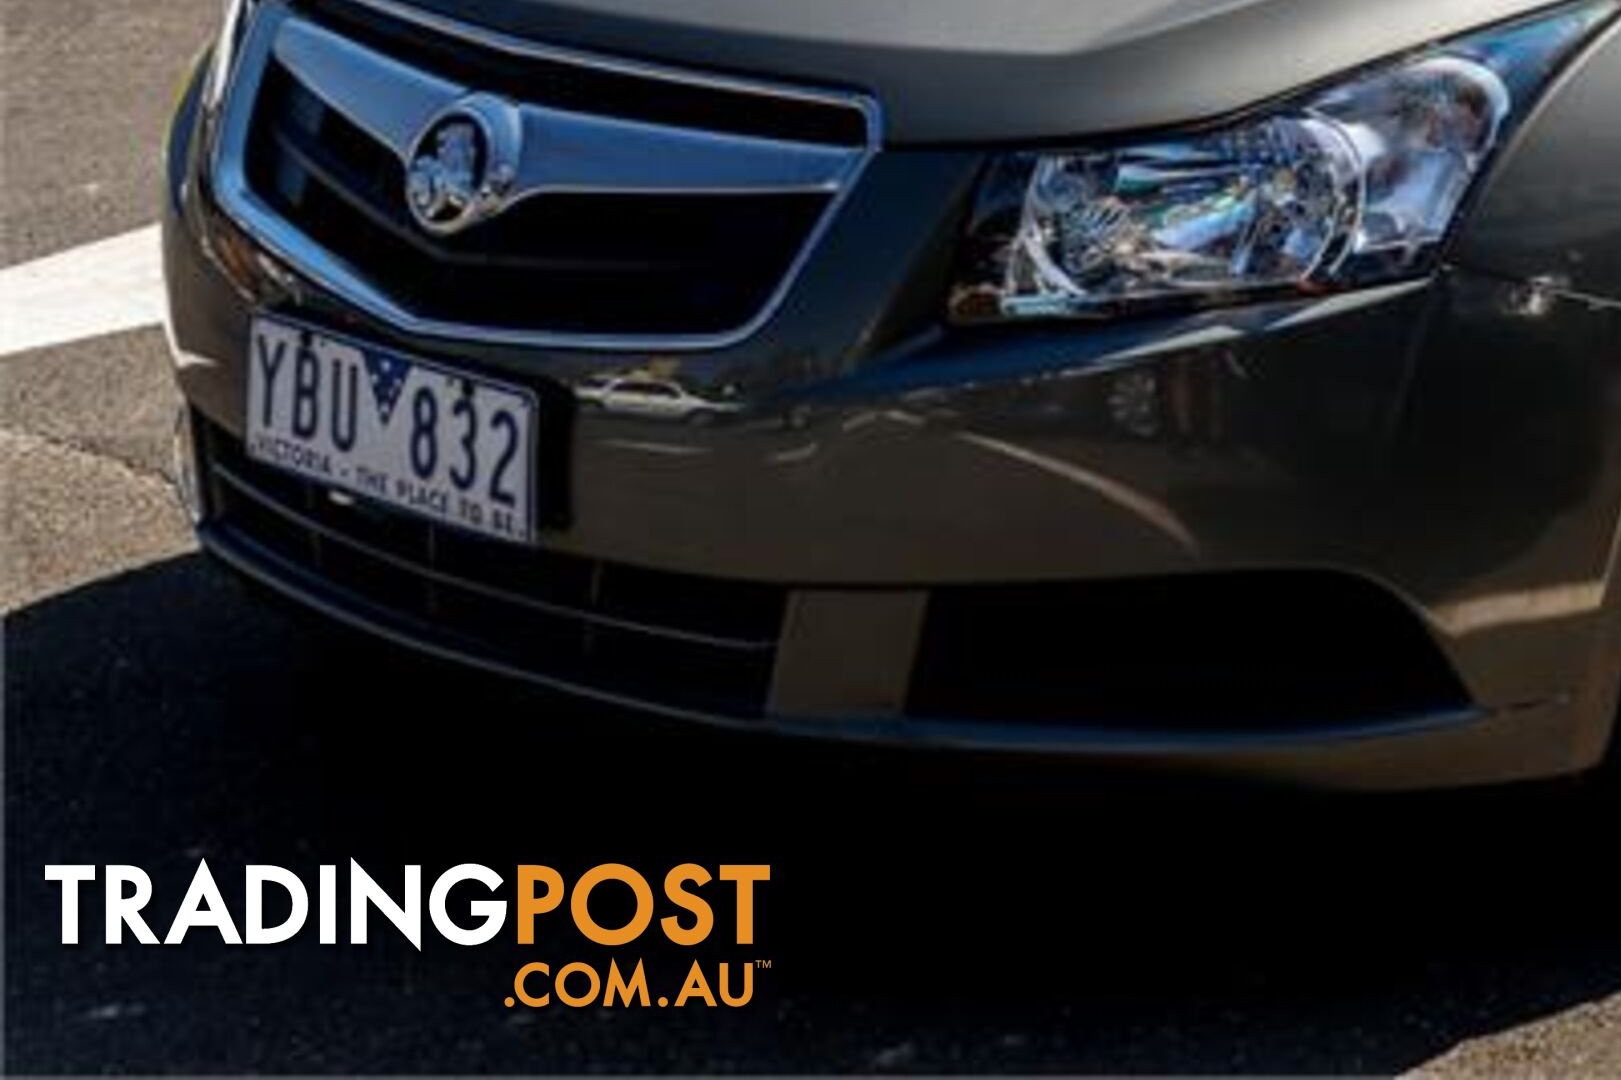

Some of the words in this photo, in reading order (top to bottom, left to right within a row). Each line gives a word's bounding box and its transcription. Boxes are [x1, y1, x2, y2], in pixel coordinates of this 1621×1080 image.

[257, 333, 358, 452] YBU
[409, 385, 519, 509] 832
[357, 467, 388, 497] THE
[396, 478, 447, 514] PLACE
[459, 499, 483, 522] TO
[493, 510, 514, 532] BE
